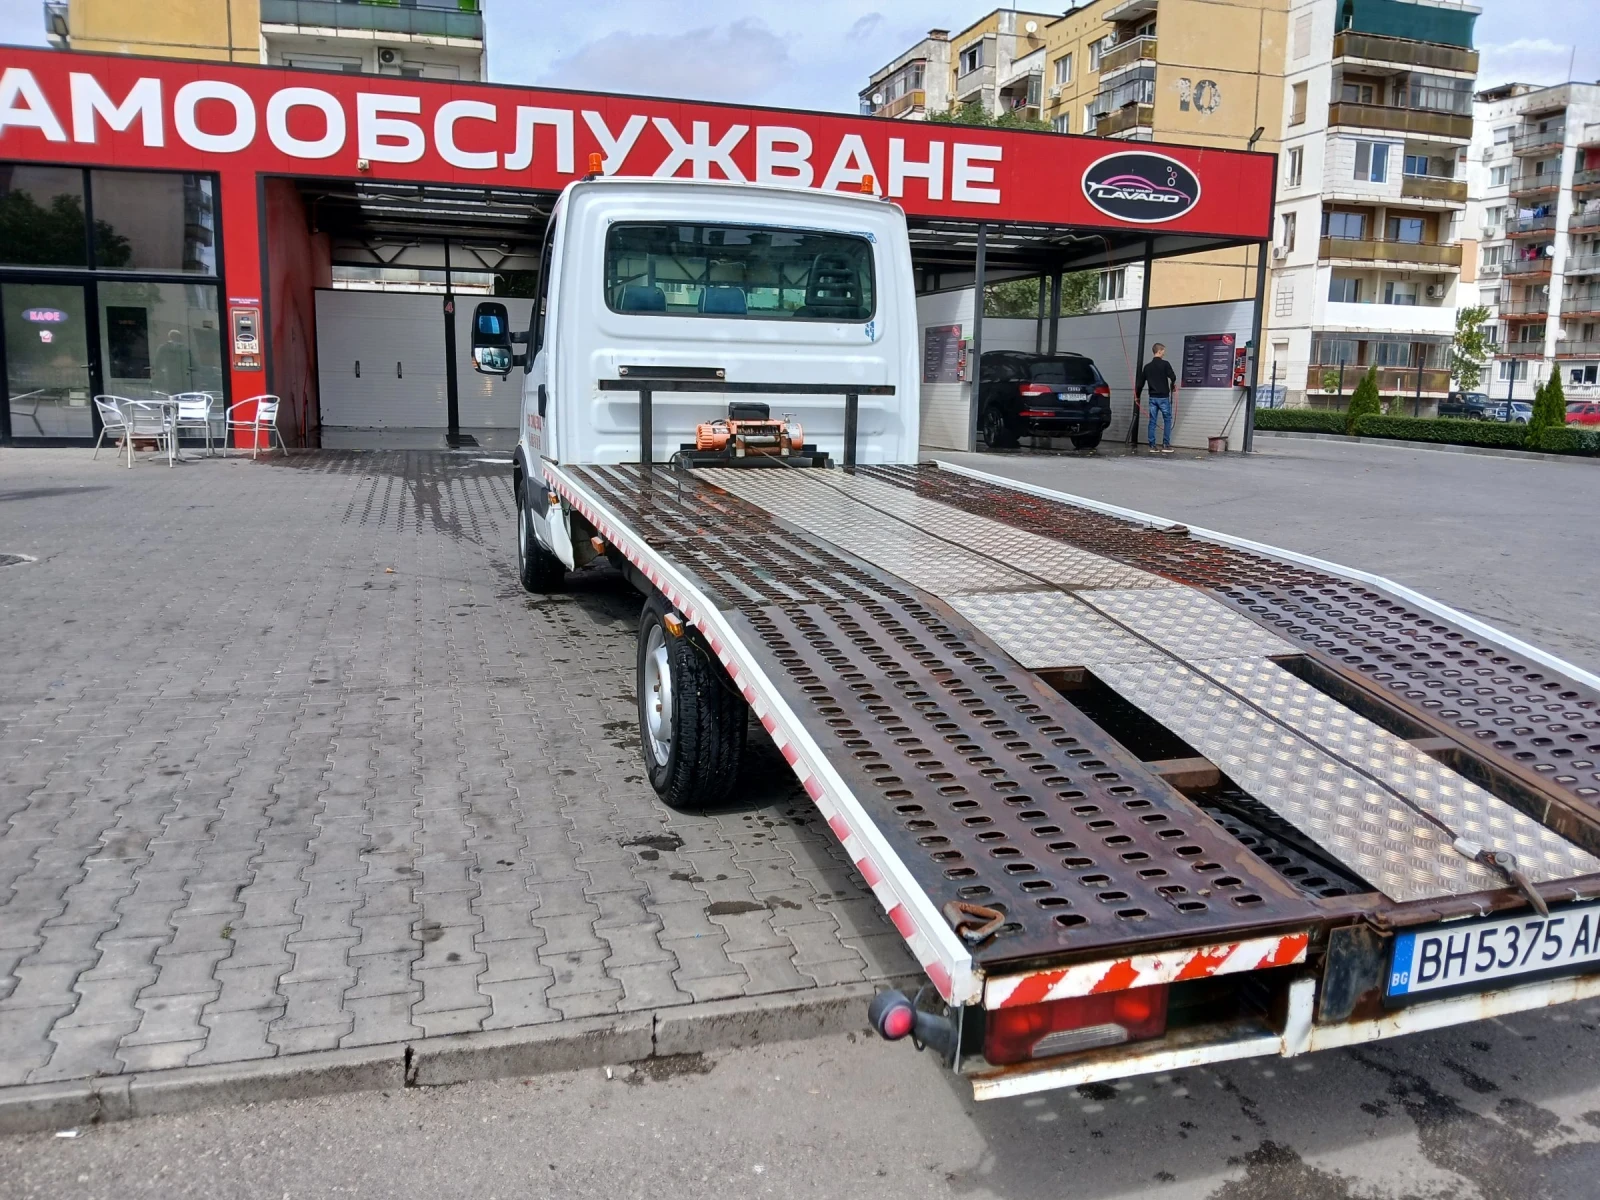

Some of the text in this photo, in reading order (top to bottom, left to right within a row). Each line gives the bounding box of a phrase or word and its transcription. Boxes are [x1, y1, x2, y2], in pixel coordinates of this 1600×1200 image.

[1176, 77, 1221, 114] 10
[0, 67, 1003, 204] АМООБСЛУЖВАНЕ
[1097, 190, 1179, 203] LAVADO
[445, 301, 454, 313] 4
[29, 311, 60, 321] КАФЕ
[1391, 972, 1408, 987] BG
